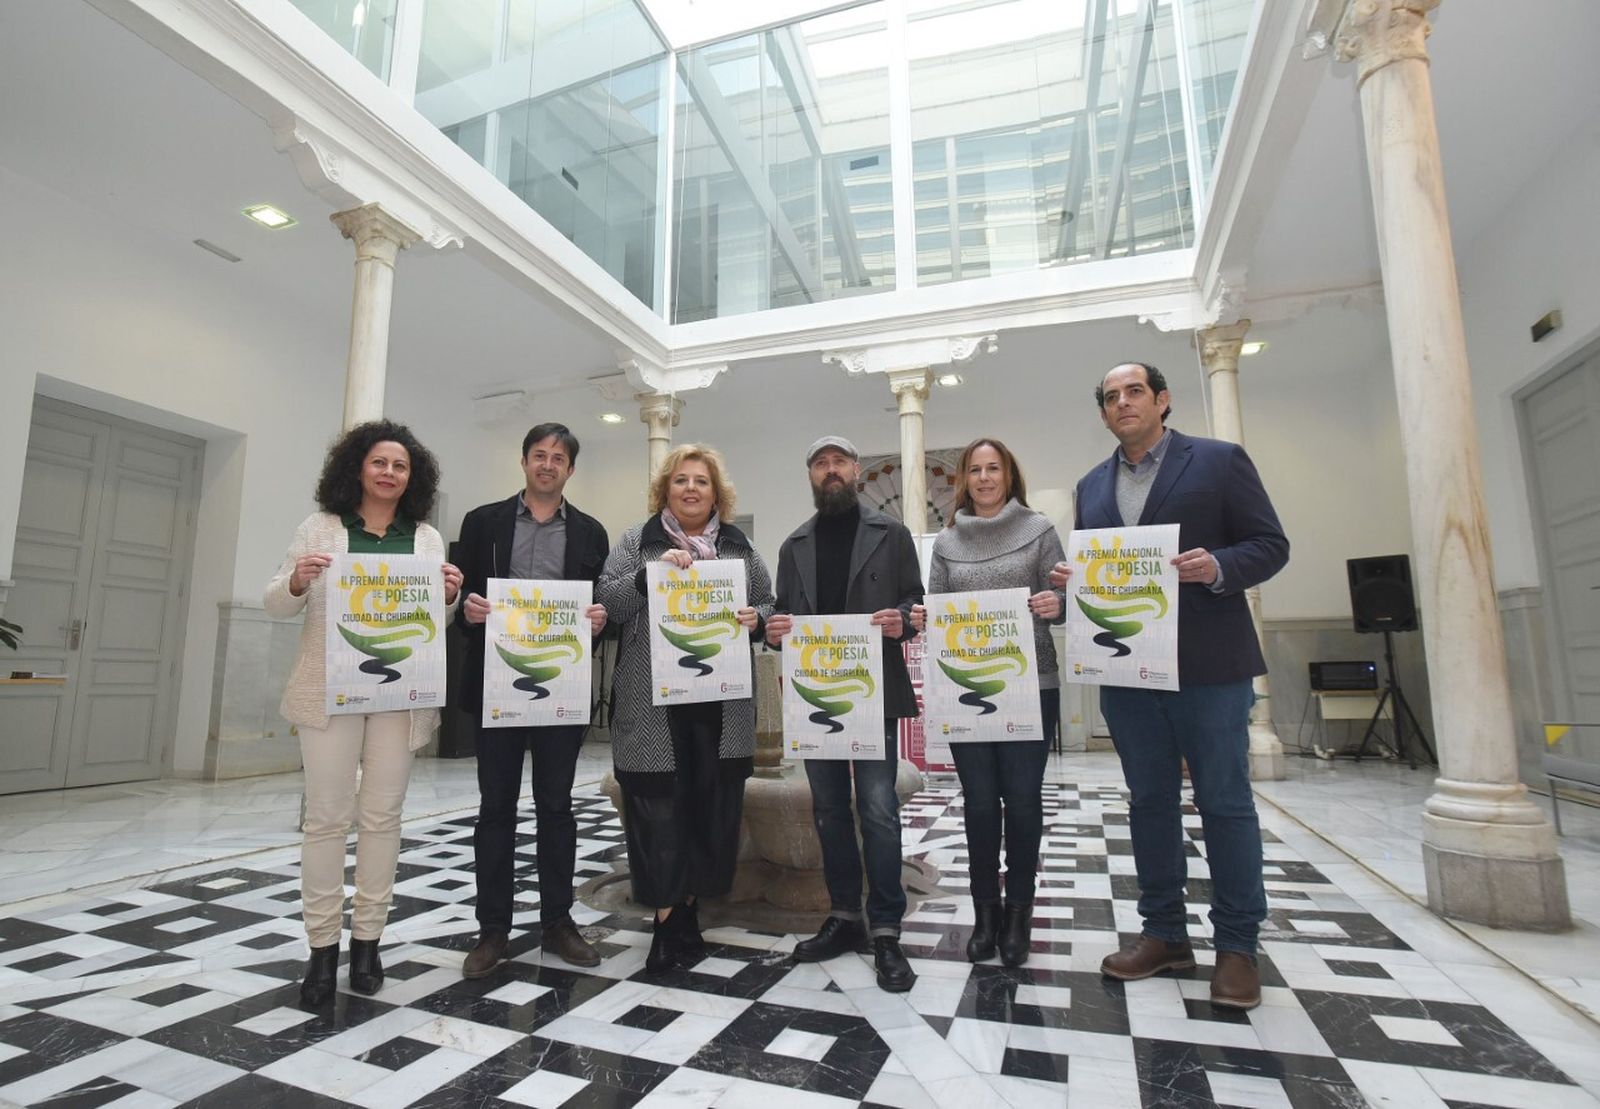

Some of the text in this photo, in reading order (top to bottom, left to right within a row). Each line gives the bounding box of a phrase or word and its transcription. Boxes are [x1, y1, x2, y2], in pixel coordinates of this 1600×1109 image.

[1086, 550, 1116, 559] PREMIO
[1120, 548, 1164, 558] NACIONAL
[350, 576, 385, 585] PREMIO
[388, 576, 432, 585] NACIONAL
[667, 580, 695, 590] PREMIO
[698, 579, 734, 589] NACIONAL
[1079, 586, 1105, 595] CIUDAD
[1118, 586, 1163, 595] CHURRIANA
[508, 600, 537, 609] PREMIO
[541, 600, 579, 609] NACIONAL
[342, 613, 371, 622] CIUDAD
[386, 612, 431, 621] CHURRIANA
[662, 614, 686, 623] CIUDAD
[699, 611, 736, 621] CHURRIANA
[945, 613, 974, 624] PREMIO
[977, 610, 1018, 622] NACIONAL
[499, 634, 525, 642] CIUDAD
[539, 634, 577, 642] CHURRIANA
[800, 636, 828, 645] PREMIO
[831, 635, 870, 644] NACIONAL
[941, 648, 965, 658] CIUDAD
[979, 646, 1022, 656] CHURRIANA
[795, 669, 818, 678] CIUDAD
[831, 669, 869, 677] CHURRIANA
